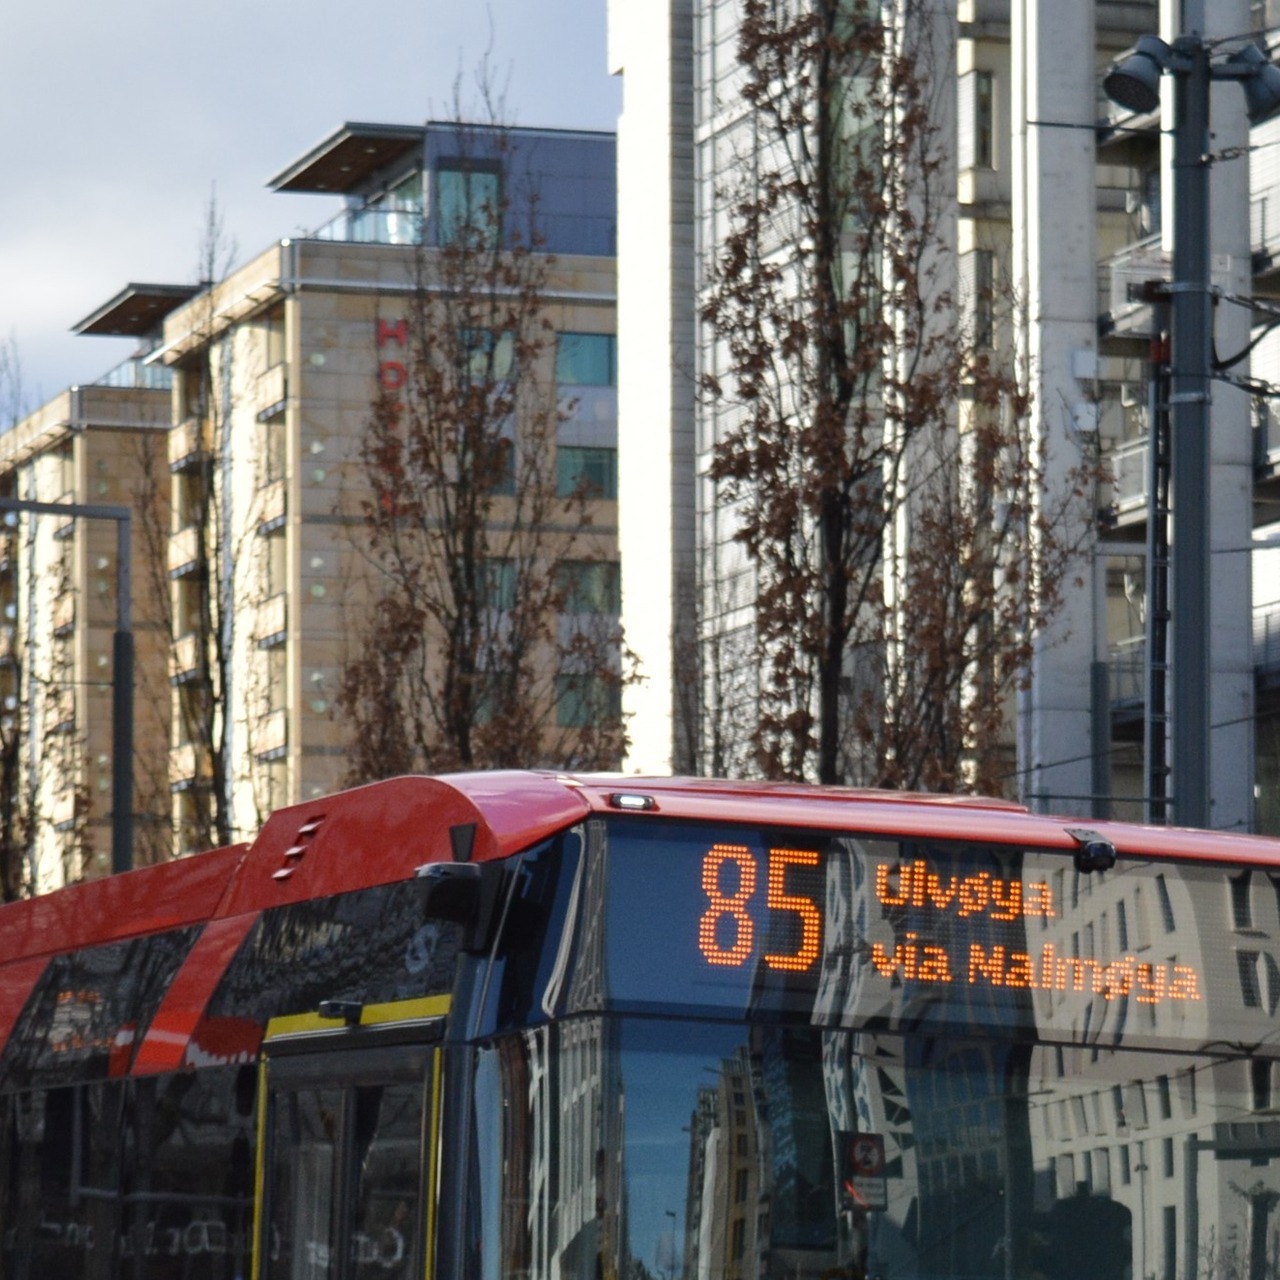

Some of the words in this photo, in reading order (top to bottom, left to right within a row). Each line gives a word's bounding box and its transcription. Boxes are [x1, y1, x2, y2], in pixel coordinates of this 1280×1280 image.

[698, 843, 820, 972] 85
[875, 859, 1056, 921] Ulvøya
[871, 931, 953, 983] via
[968, 942, 1202, 1005] Malmøya
